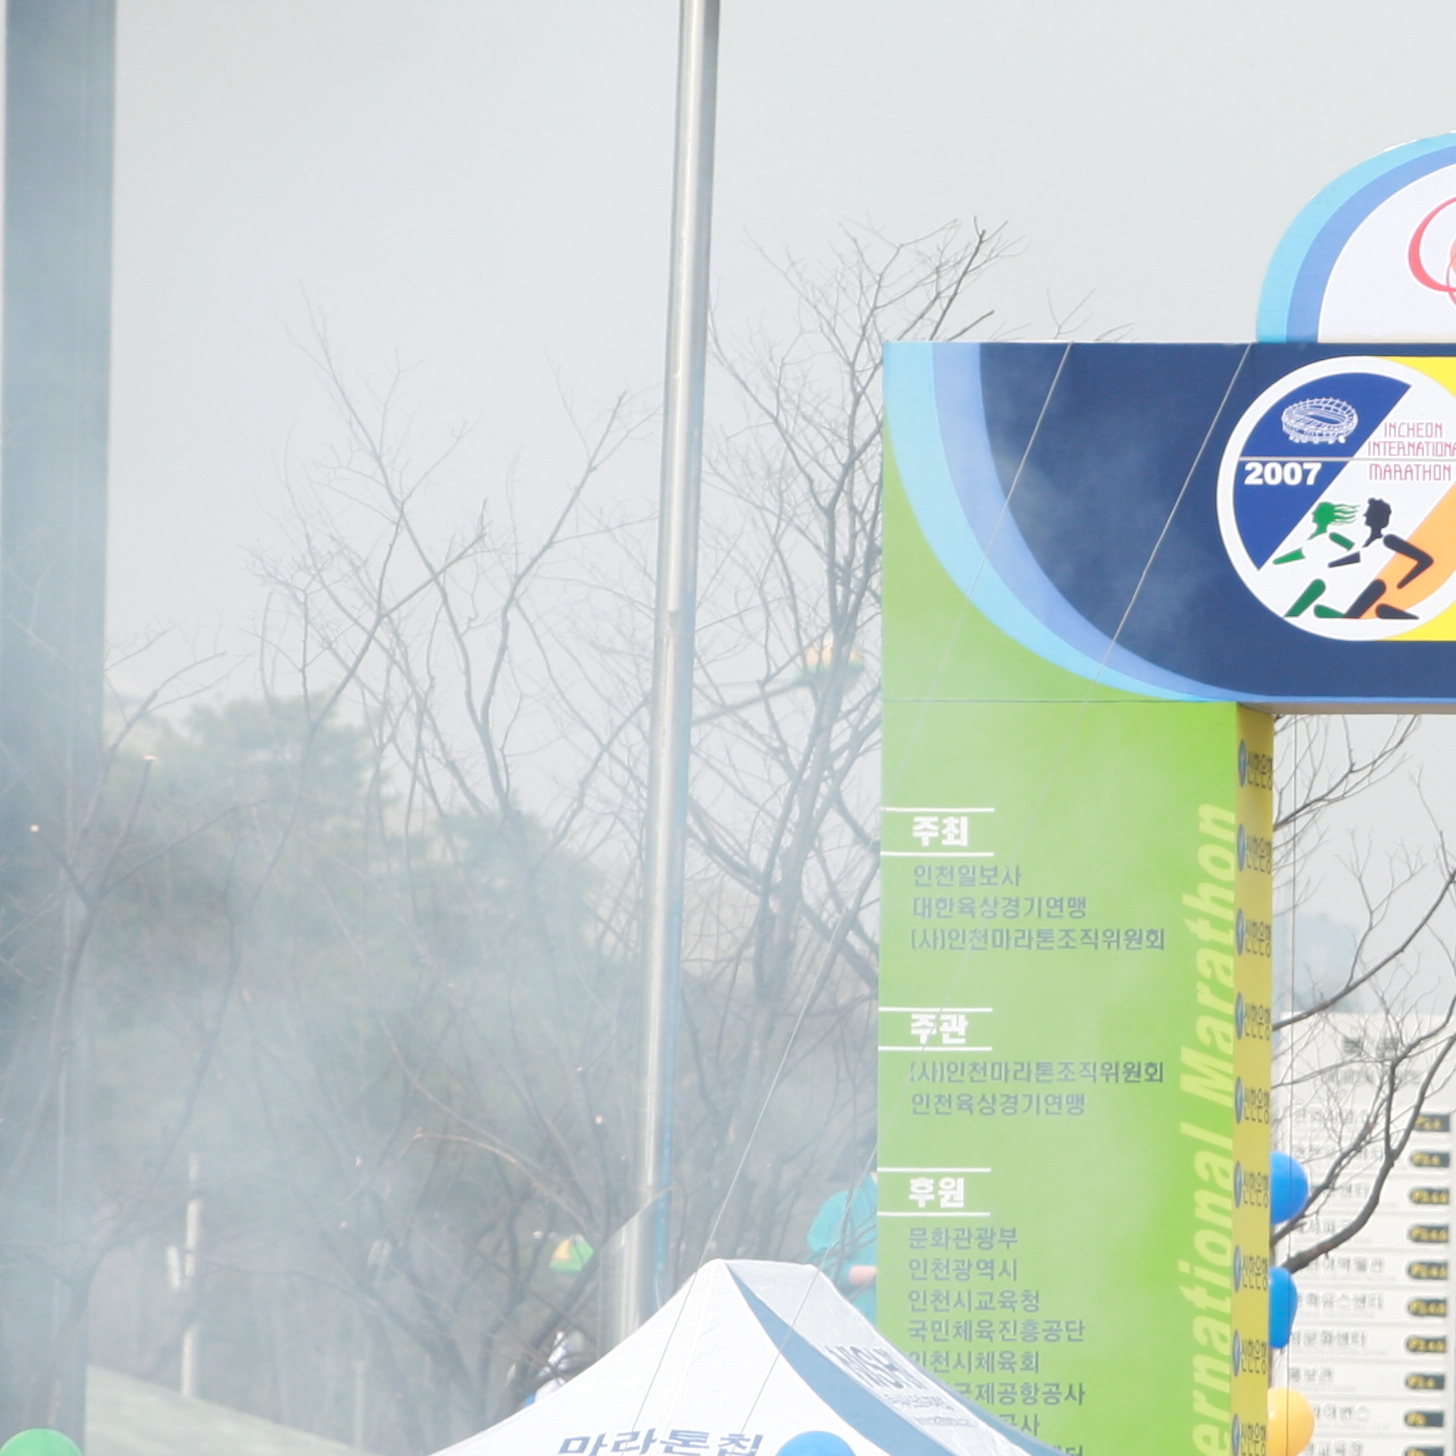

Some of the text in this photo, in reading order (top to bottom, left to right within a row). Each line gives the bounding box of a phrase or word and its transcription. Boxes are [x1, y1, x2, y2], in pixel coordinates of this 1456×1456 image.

[1384, 422, 1443, 439] INCHEON
[1244, 462, 1322, 486] 2007
[1368, 463, 1451, 481] MARATHON
[911, 816, 969, 846] 주최
[913, 865, 1022, 887] 인천일보사
[912, 897, 1087, 919] 대한육상경기연맹
[1180, 803, 1236, 1108] Marathon
[910, 1014, 968, 1045] 주관
[911, 1093, 1086, 1116] 인천육상경기연맹
[909, 1177, 965, 1208] 후원
[907, 1227, 1018, 1250] 문화관광부
[908, 1258, 1019, 1282] 인천광역시
[908, 1289, 1040, 1313] 인천시교육청
[908, 1320, 1085, 1344] 국민체육진흥공단
